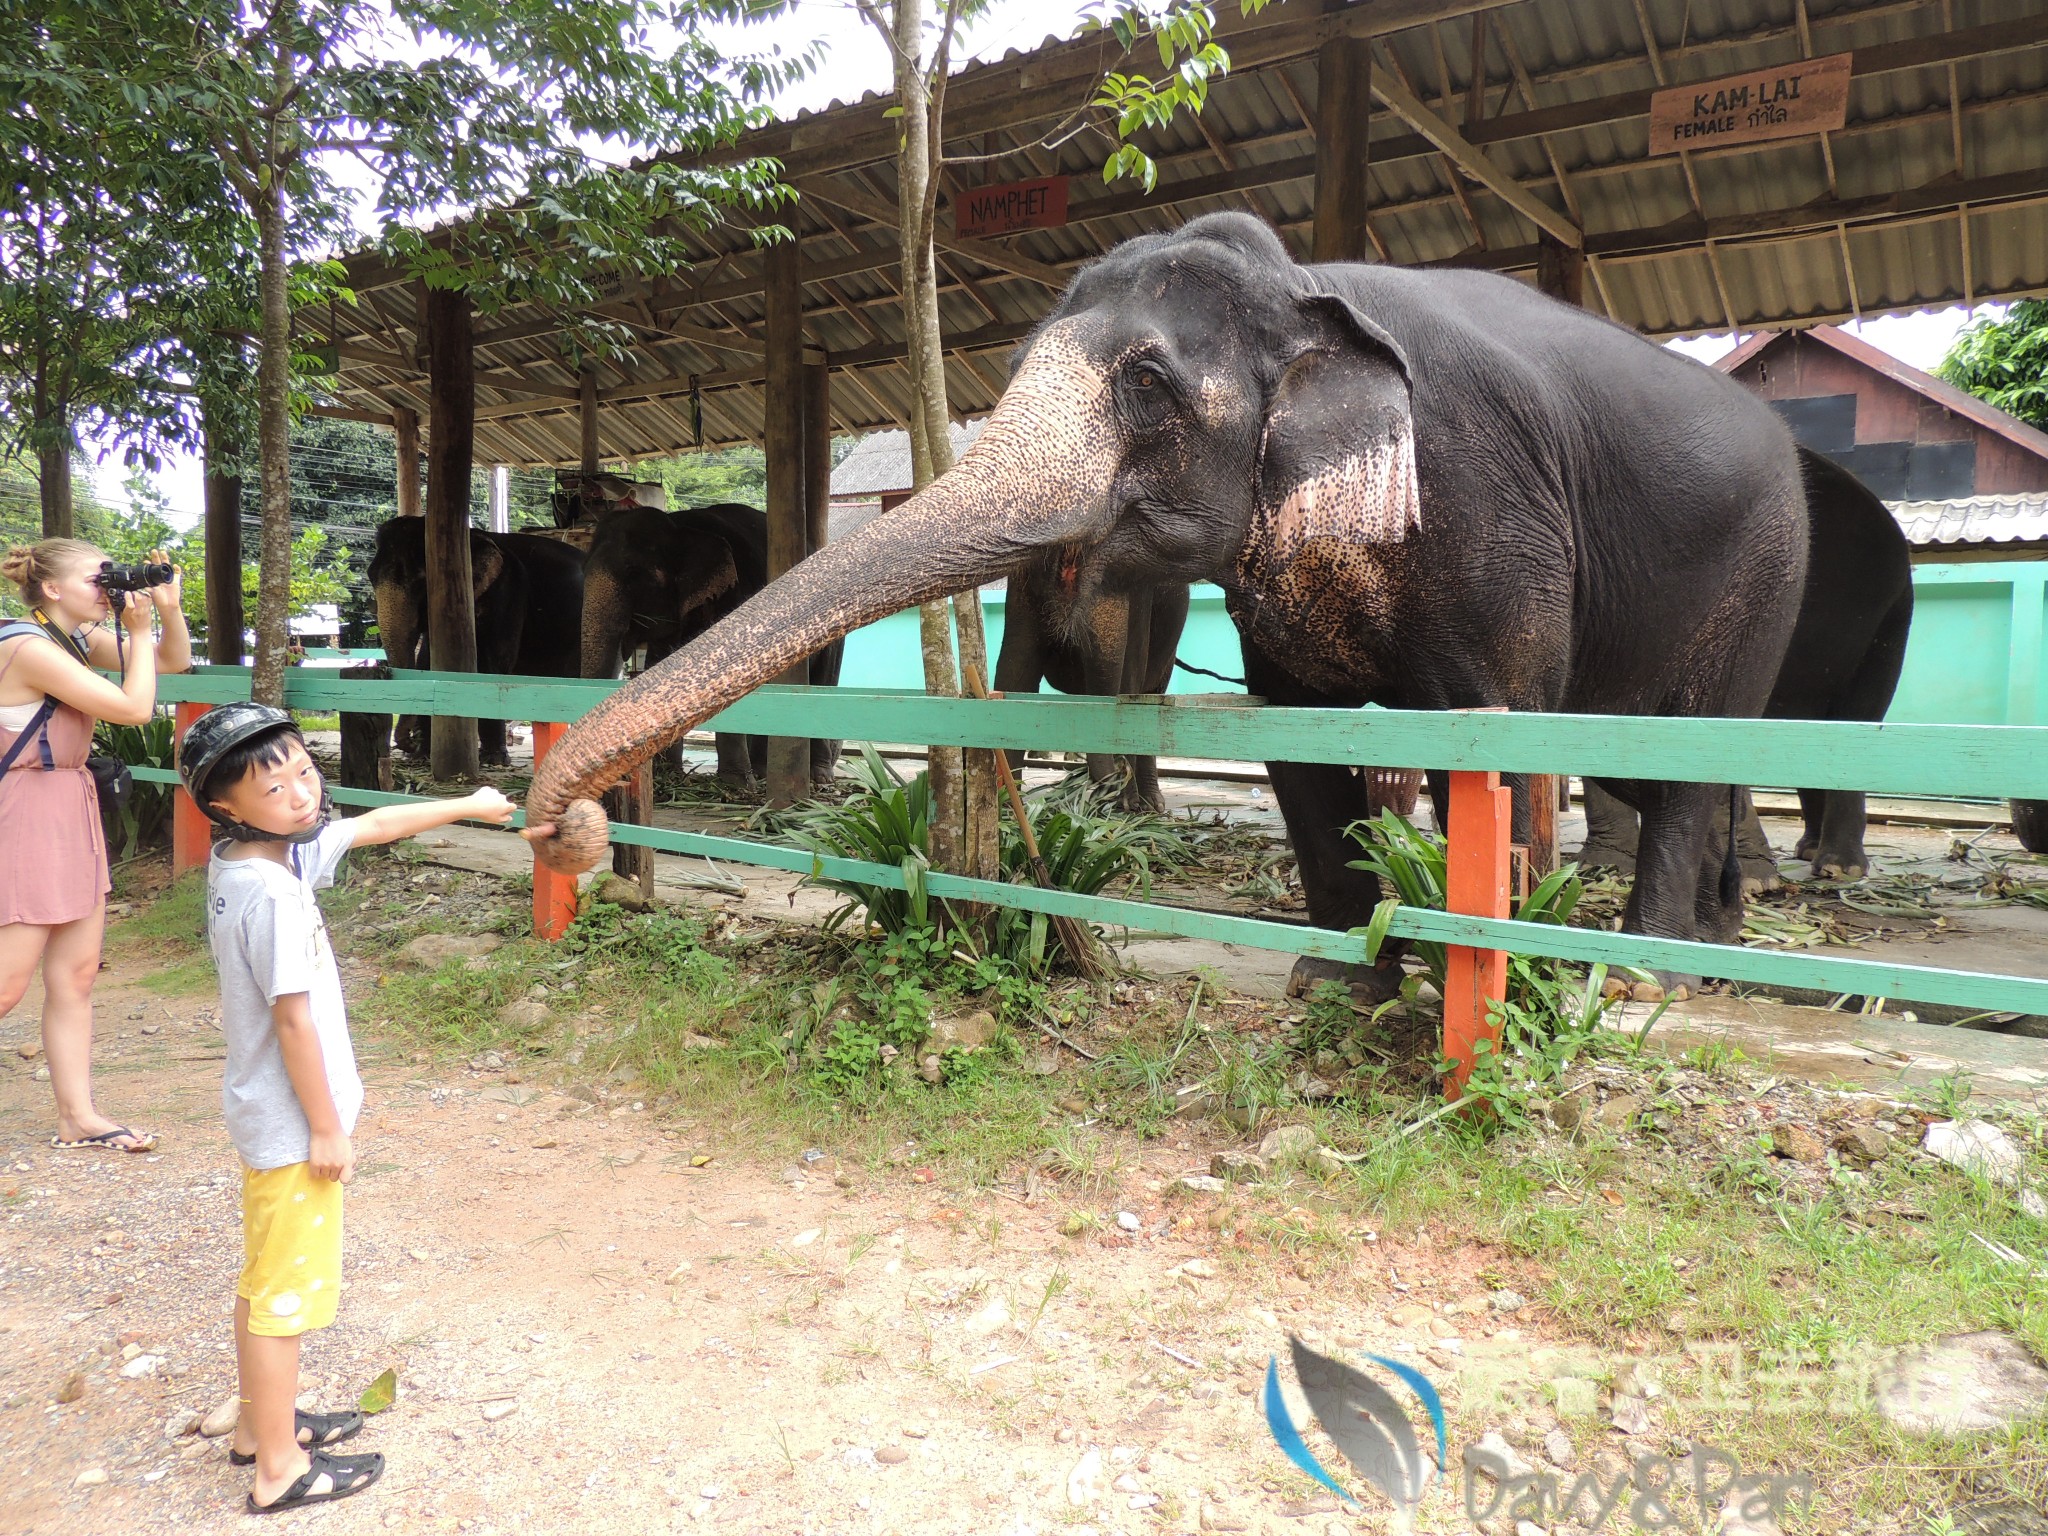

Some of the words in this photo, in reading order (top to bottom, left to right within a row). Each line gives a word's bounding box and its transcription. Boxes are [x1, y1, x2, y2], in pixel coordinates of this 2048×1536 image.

[1693, 75, 1802, 118] KAM-LAI
[1673, 115, 1735, 141] FEMALE
[970, 186, 1049, 225] NAMPHET
